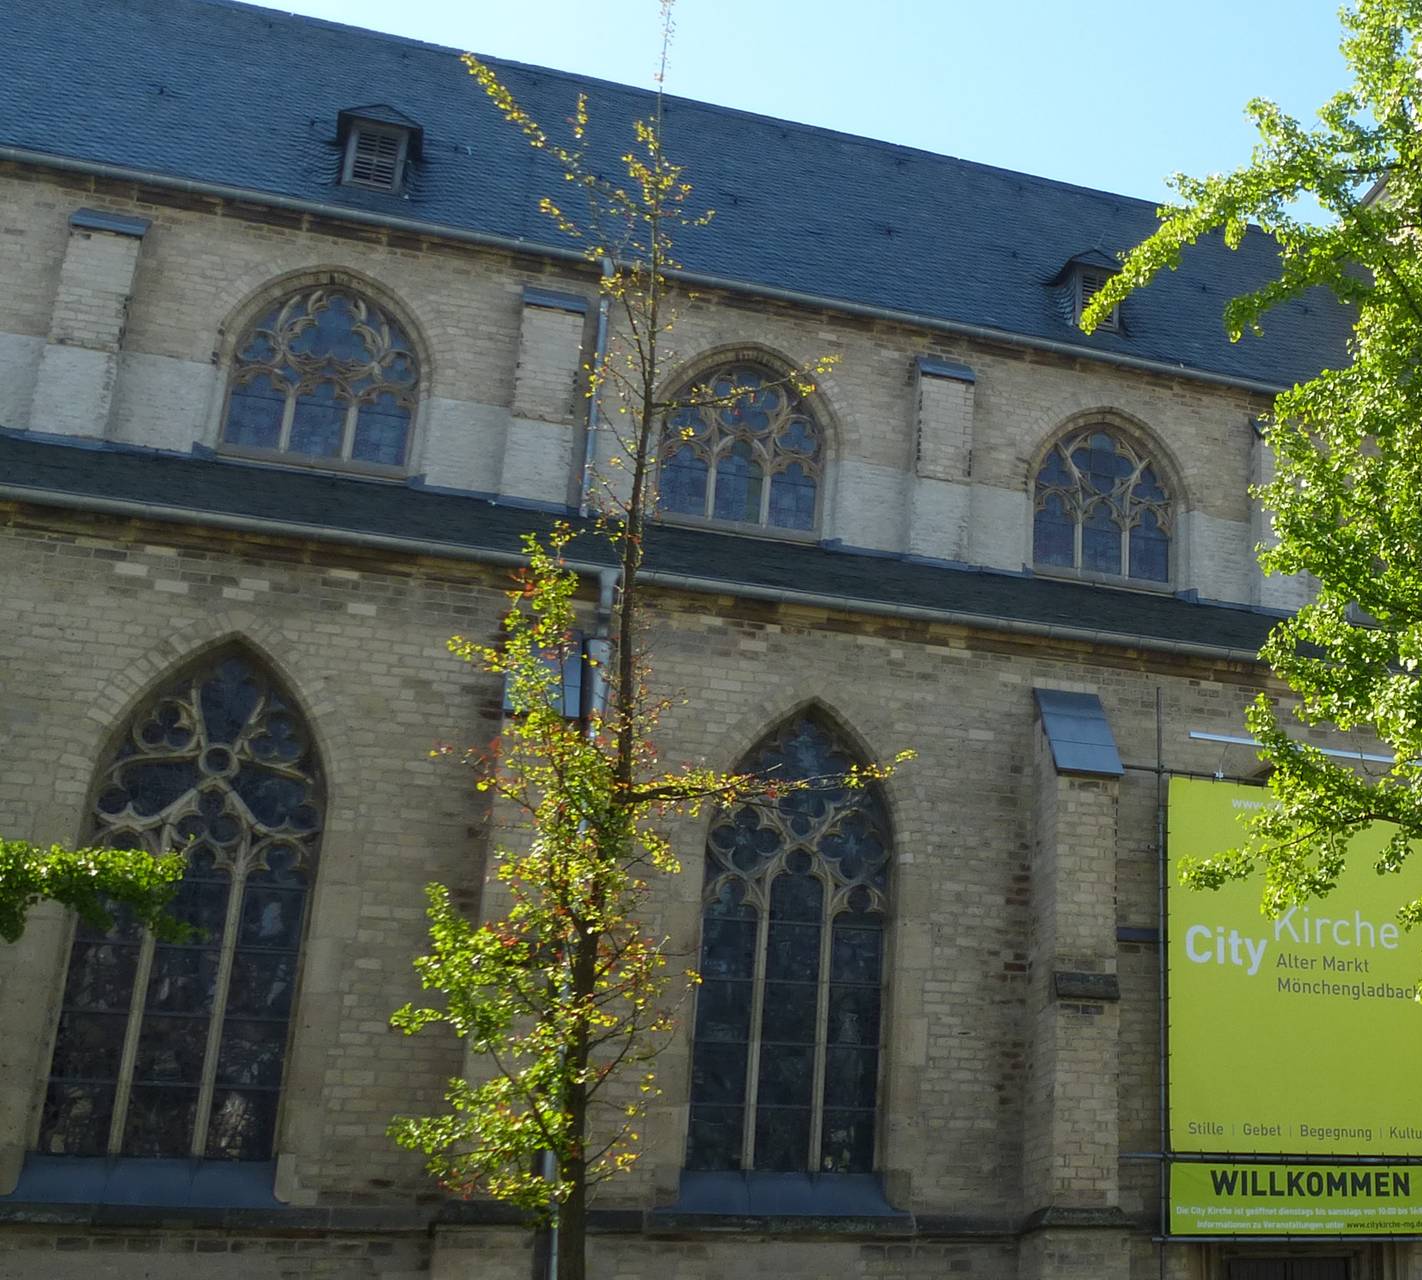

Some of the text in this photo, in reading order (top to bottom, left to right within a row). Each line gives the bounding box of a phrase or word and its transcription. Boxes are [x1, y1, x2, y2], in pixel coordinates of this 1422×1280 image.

[1185, 905, 1399, 976] City Kirche
[1276, 952, 1369, 974] Alter Markt
[1188, 1122, 1224, 1136] Stille
[1243, 1123, 1281, 1137] Gebet
[1300, 1125, 1372, 1141] Begegnung
[1210, 1170, 1411, 1197] WILLKOMMEN
[1176, 1206, 1189, 1215] Die
[1190, 1206, 1206, 1217] City
[1207, 1206, 1233, 1216] Kirche
[1234, 1207, 1244, 1216] ist
[1278, 1207, 1313, 1217] dienstags
[1197, 1220, 1251, 1229] Informationen
[1263, 1221, 1323, 1231] Veranstaltungen
[1325, 1221, 1345, 1230] unter
